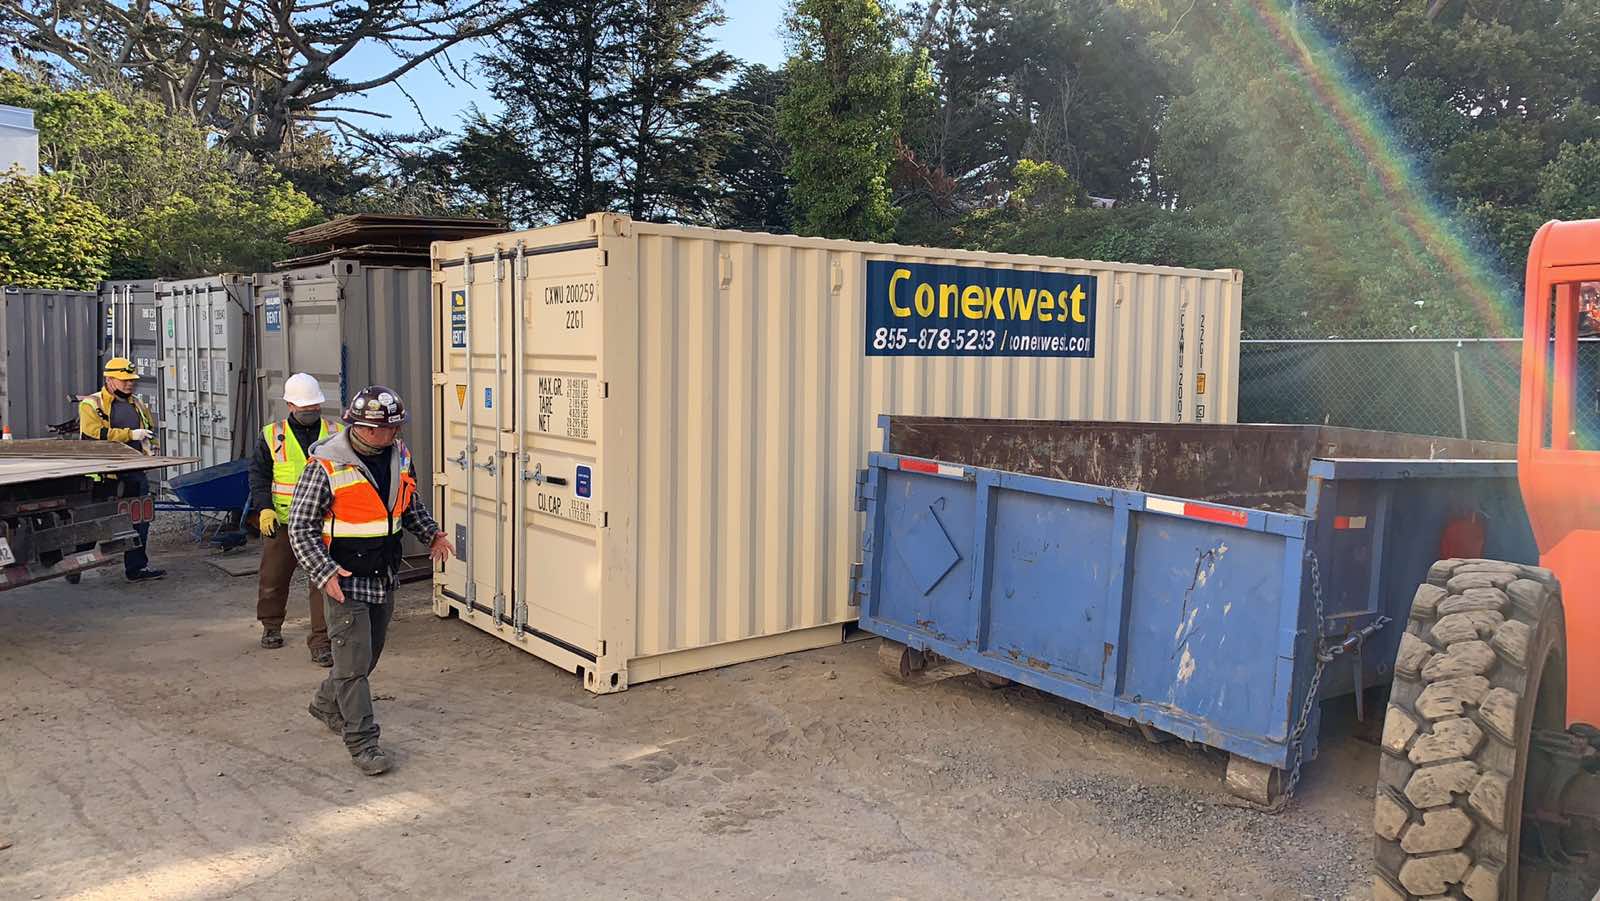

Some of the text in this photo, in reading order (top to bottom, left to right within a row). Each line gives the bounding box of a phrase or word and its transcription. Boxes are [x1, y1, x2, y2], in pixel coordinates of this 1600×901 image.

[544, 285, 564, 305] CXWU
[566, 282, 595, 304] 200259
[888, 268, 1086, 323] Conexwest
[566, 310, 584, 329] 22G1
[873, 327, 996, 351] 855-878-5233
[1009, 333, 1091, 352] onewes.co
[539, 396, 553, 415] TARE
[538, 414, 551, 433] NET
[549, 496, 563, 517] CAP.
